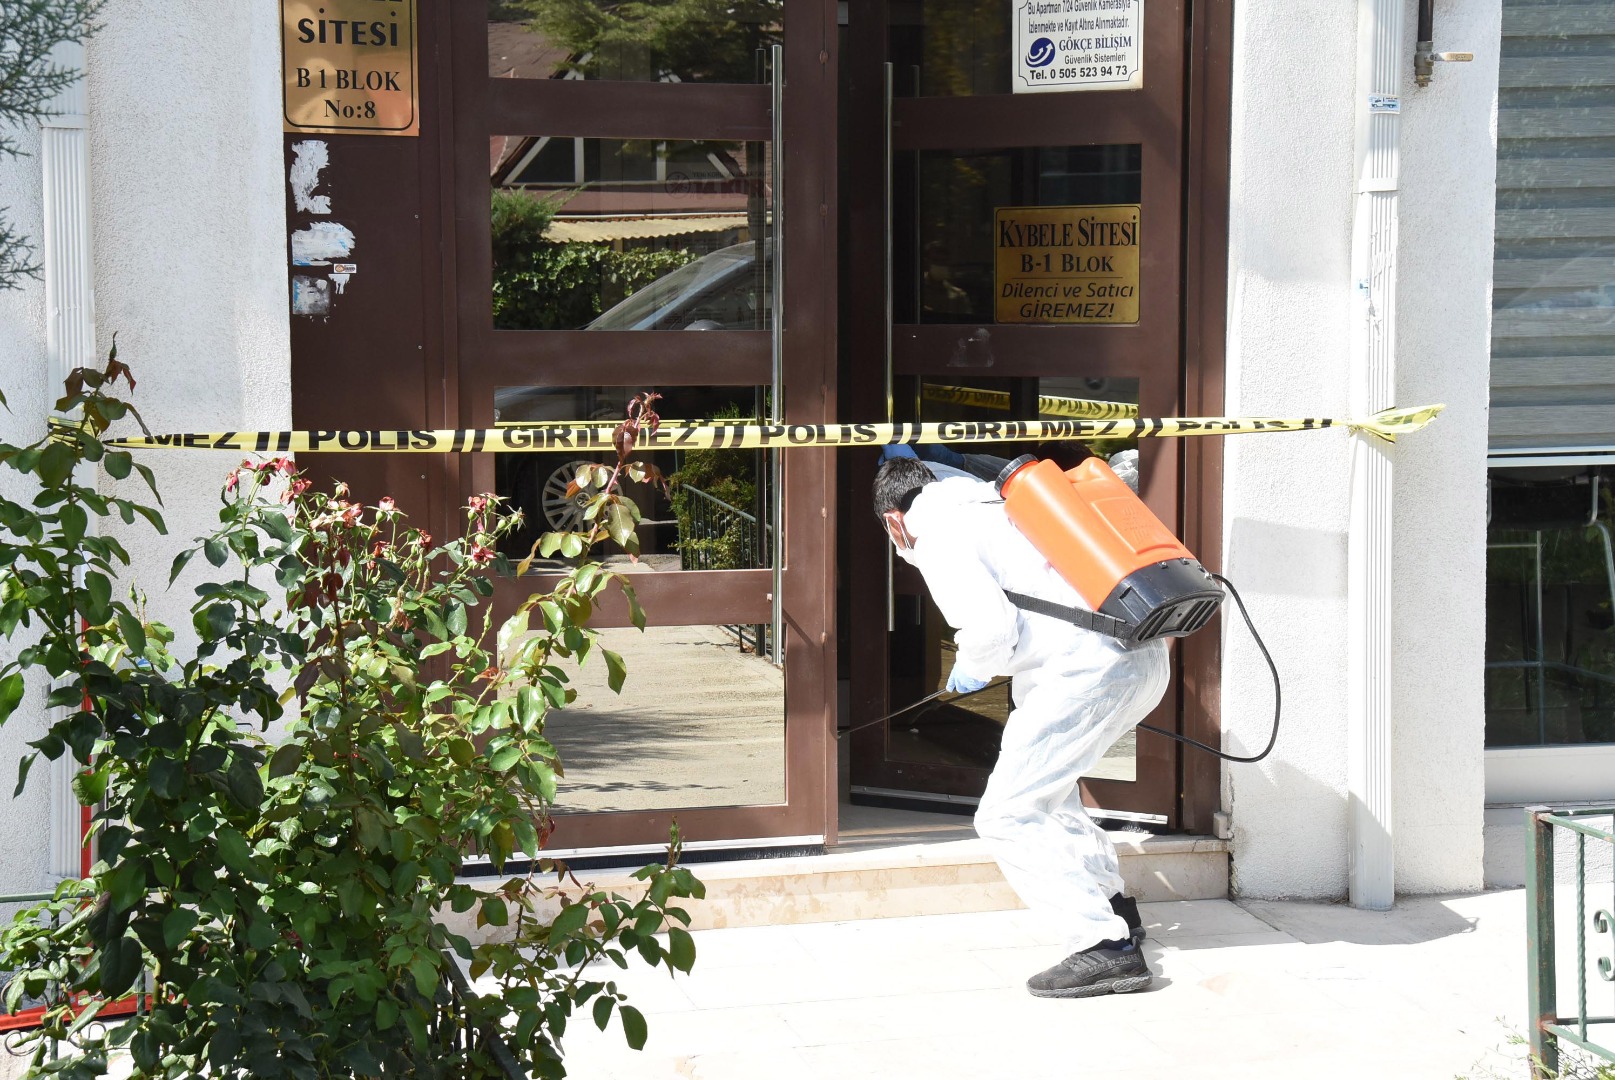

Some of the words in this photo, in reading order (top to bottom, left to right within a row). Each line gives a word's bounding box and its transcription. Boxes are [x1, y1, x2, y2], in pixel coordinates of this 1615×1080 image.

[1028, 2, 1036, 15] Bu
[1036, 2, 1061, 17] Apartman
[1062, 1, 1073, 13] 7/24
[298, 8, 398, 46] SİTESİ
[1028, 18, 1056, 34] İzlenmekte
[1057, 22, 1064, 32] ve
[1064, 18, 1079, 34] Kayıt
[1059, 36, 1092, 53] GÖKÇE
[1095, 34, 1132, 51] BİLİŞİM
[1064, 55, 1093, 65] Güvenlik
[1094, 52, 1126, 63] Sistemleri
[296, 67, 311, 88] B
[318, 69, 328, 89] 1
[336, 70, 401, 91] BLOK
[1030, 69, 1048, 80] Tel.
[1050, 68, 1056, 79] 0
[1058, 68, 1077, 78] 505
[1079, 66, 1098, 77] 523
[1100, 65, 1113, 76] 94
[1115, 65, 1128, 76] 73
[324, 99, 376, 119] No:8
[999, 219, 1074, 248] KYBELE
[1077, 215, 1138, 247] SİTESİ
[1021, 253, 1052, 273] B-1
[1061, 253, 1114, 273] BLOK
[1002, 282, 1059, 298] Dilenci
[1063, 286, 1082, 298] ve
[1086, 282, 1133, 298] Satıcı
[1020, 299, 1114, 318] GİREMEZ!
